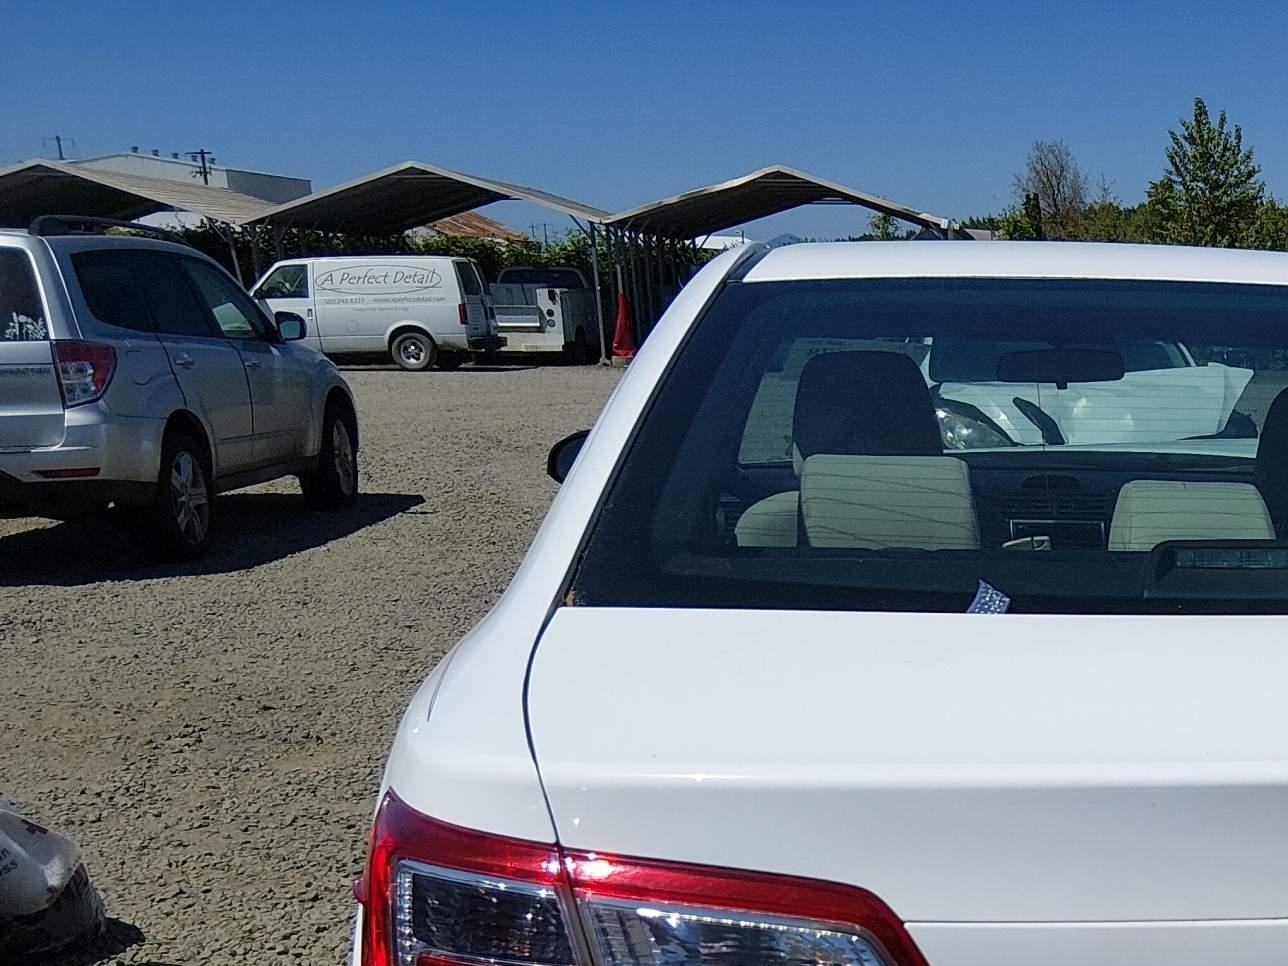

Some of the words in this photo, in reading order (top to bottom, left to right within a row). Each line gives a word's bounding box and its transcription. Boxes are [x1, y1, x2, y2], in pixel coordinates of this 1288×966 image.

[321, 272, 334, 286] A
[339, 268, 389, 285] Perfect
[393, 268, 436, 284] Detail
